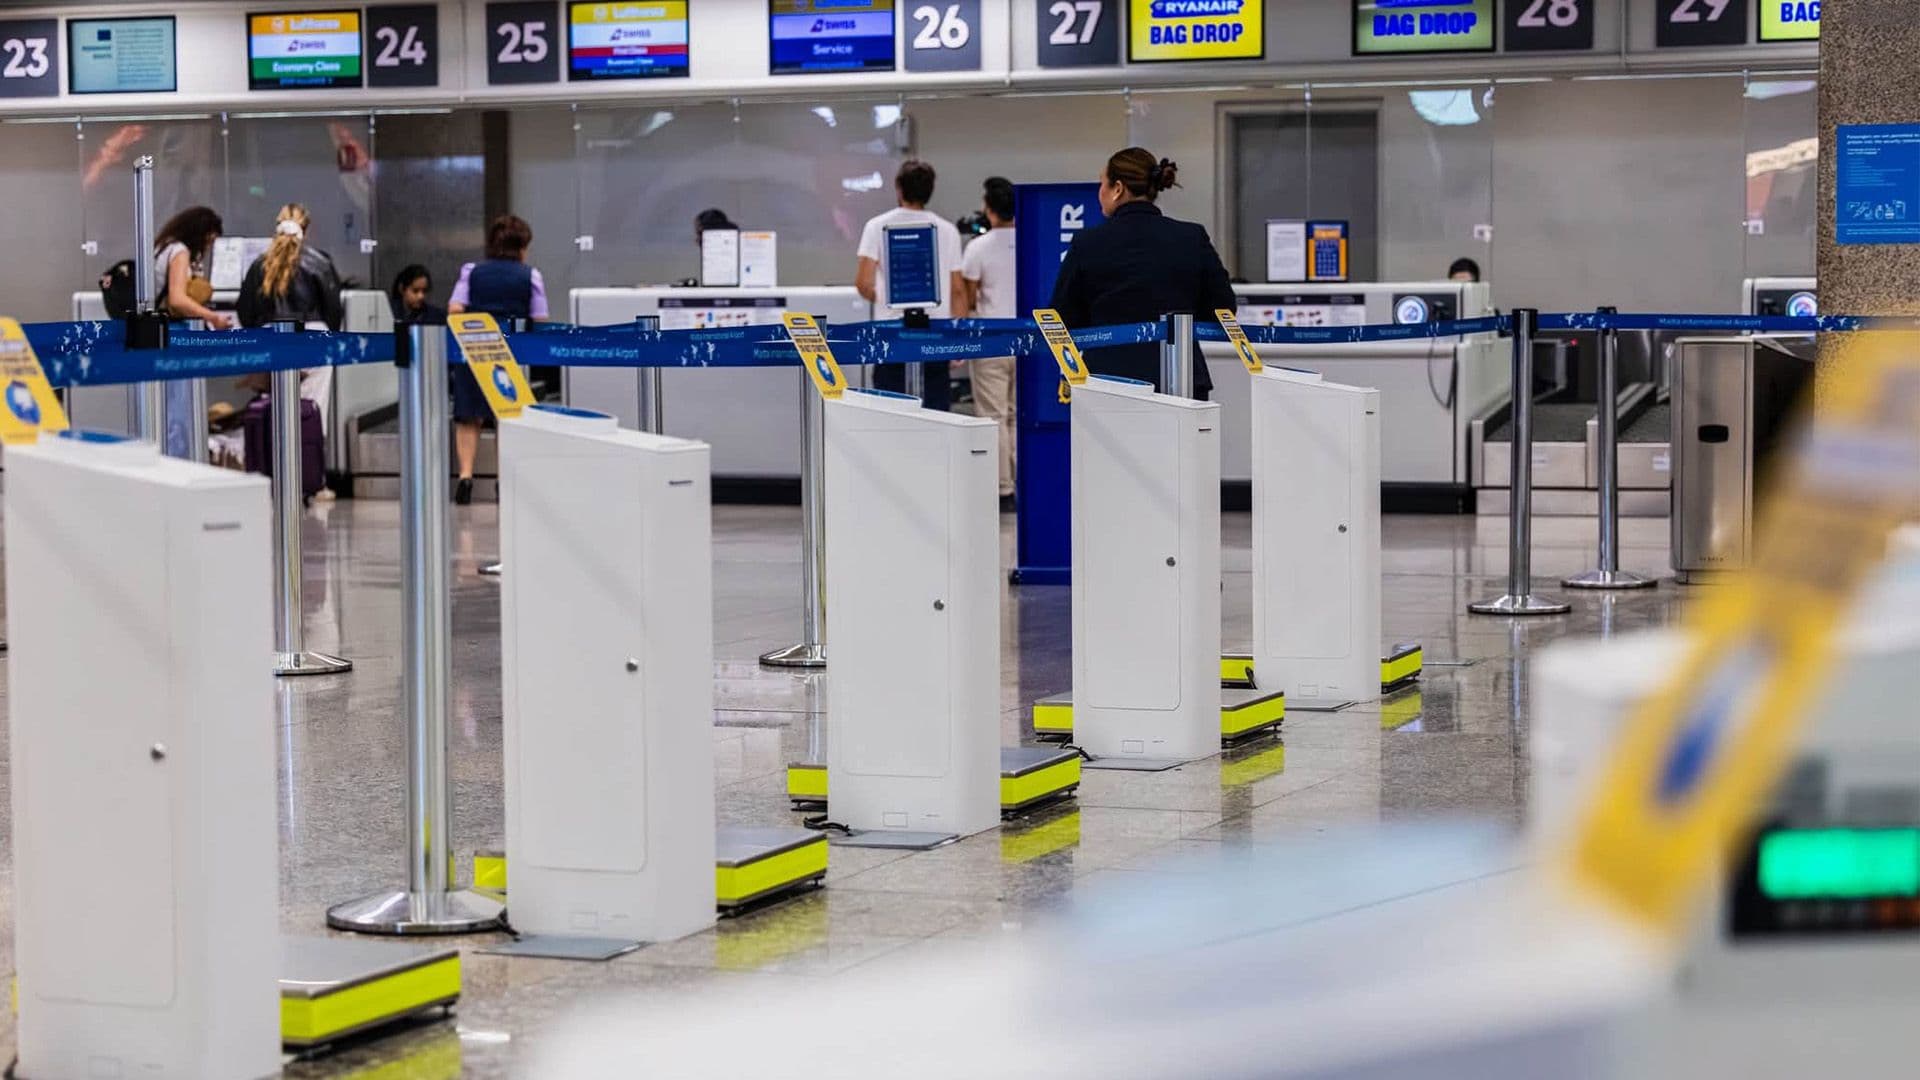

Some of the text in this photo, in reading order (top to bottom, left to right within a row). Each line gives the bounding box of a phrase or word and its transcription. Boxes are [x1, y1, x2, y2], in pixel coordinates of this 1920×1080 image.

[1165, 0, 1239, 13] RYANAIR
[1517, 0, 1579, 27] 28
[1780, 1, 1820, 22] BAG
[913, 4, 970, 49] 26
[1049, 1, 1101, 45] 27
[1150, 22, 1243, 45] BAG DROP
[1373, 12, 1477, 36] BAG DROP
[375, 26, 427, 66] 24
[496, 22, 549, 63] 25
[813, 43, 853, 55] Service
[2, 38, 49, 78] 23
[272, 60, 340, 74] Economy Class
[240, 351, 270, 366] Airport
[616, 346, 639, 360] Airport
